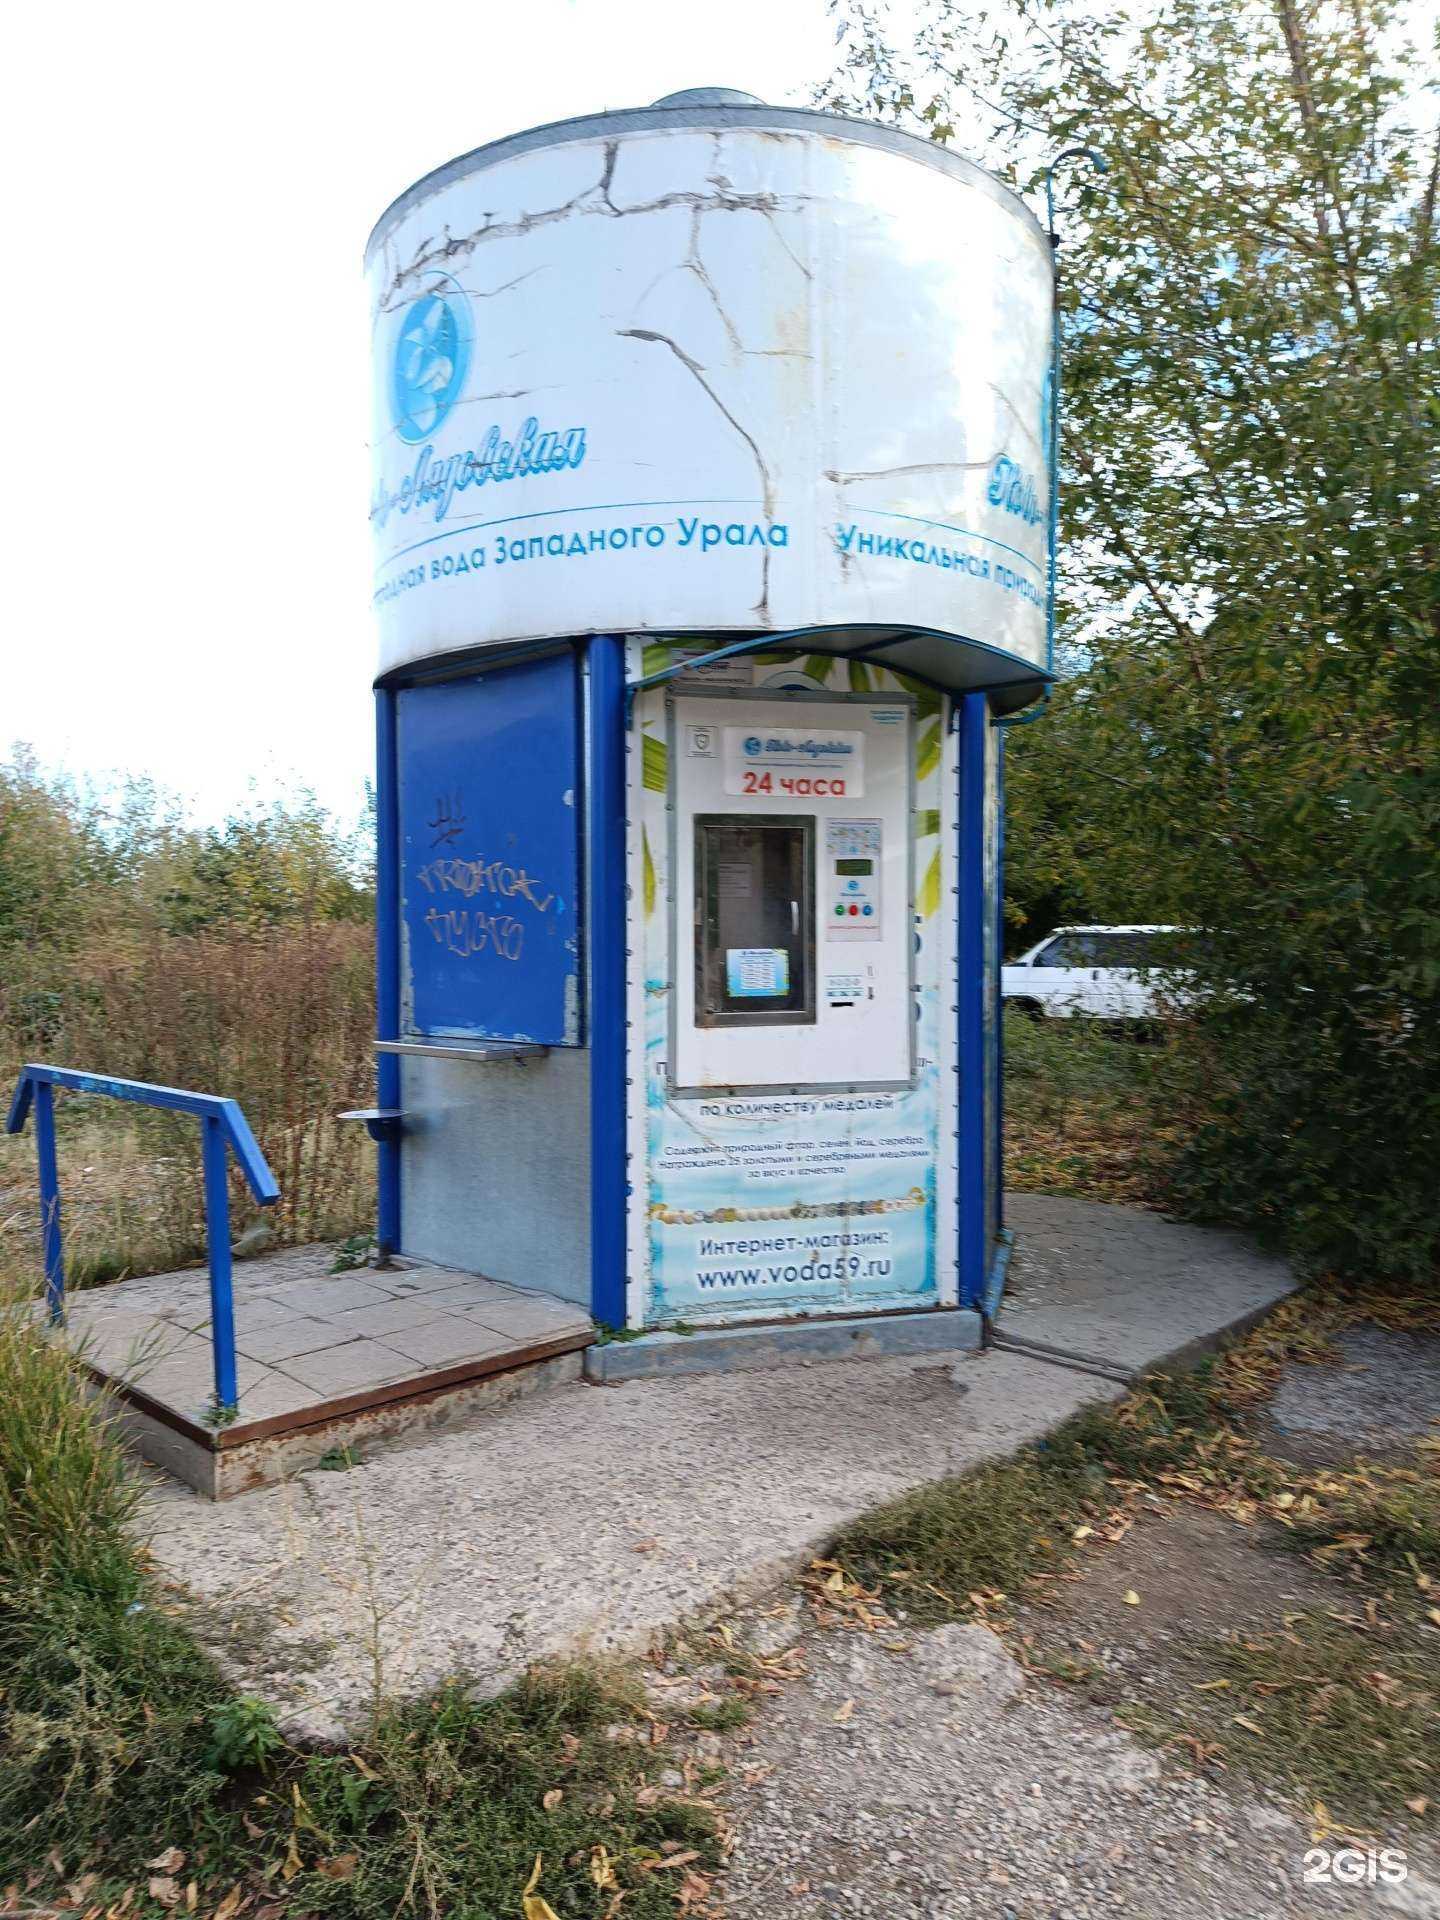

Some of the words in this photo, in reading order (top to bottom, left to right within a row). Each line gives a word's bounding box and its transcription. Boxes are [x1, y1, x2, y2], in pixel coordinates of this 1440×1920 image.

[431, 547, 486, 579] вода
[494, 526, 665, 564] Западного
[676, 517, 789, 552] Урала
[834, 522, 990, 579] Уникальная
[742, 771, 773, 794] 24
[780, 778, 846, 796] часа
[700, 1104, 721, 1117] по
[725, 1098, 817, 1115] количеству
[700, 1231, 889, 1256] Интернет-магазин:
[697, 1256, 891, 1288] www.voda59.ru
